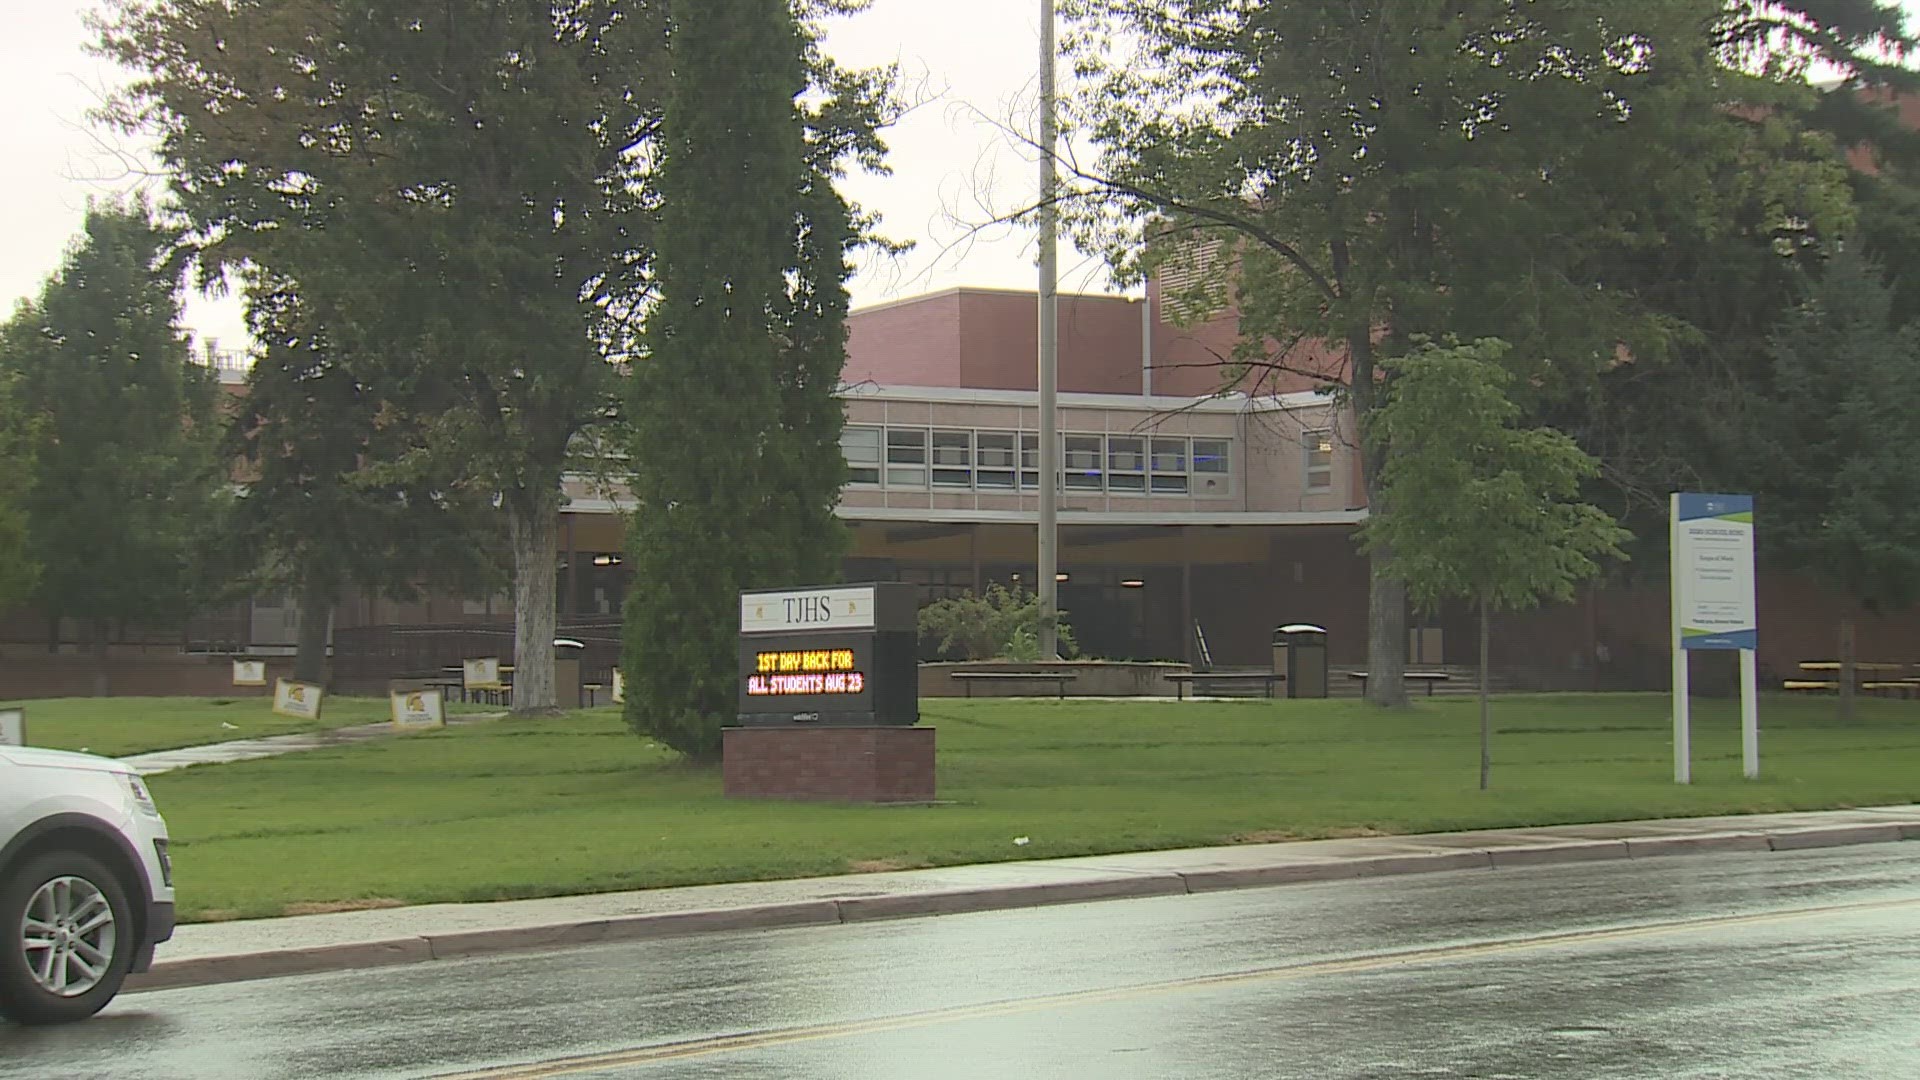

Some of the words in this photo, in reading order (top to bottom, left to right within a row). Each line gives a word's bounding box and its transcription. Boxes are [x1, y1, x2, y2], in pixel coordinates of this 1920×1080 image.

[783, 595, 831, 623] TJHS
[758, 653, 778, 671] 1ST
[780, 652, 800, 670] DAY
[803, 651, 830, 670] BACK
[831, 650, 853, 669] FOR
[748, 676, 768, 694] ALL
[769, 674, 823, 694] STUDENTS
[825, 673, 846, 692] AUG
[847, 672, 862, 692] 23
